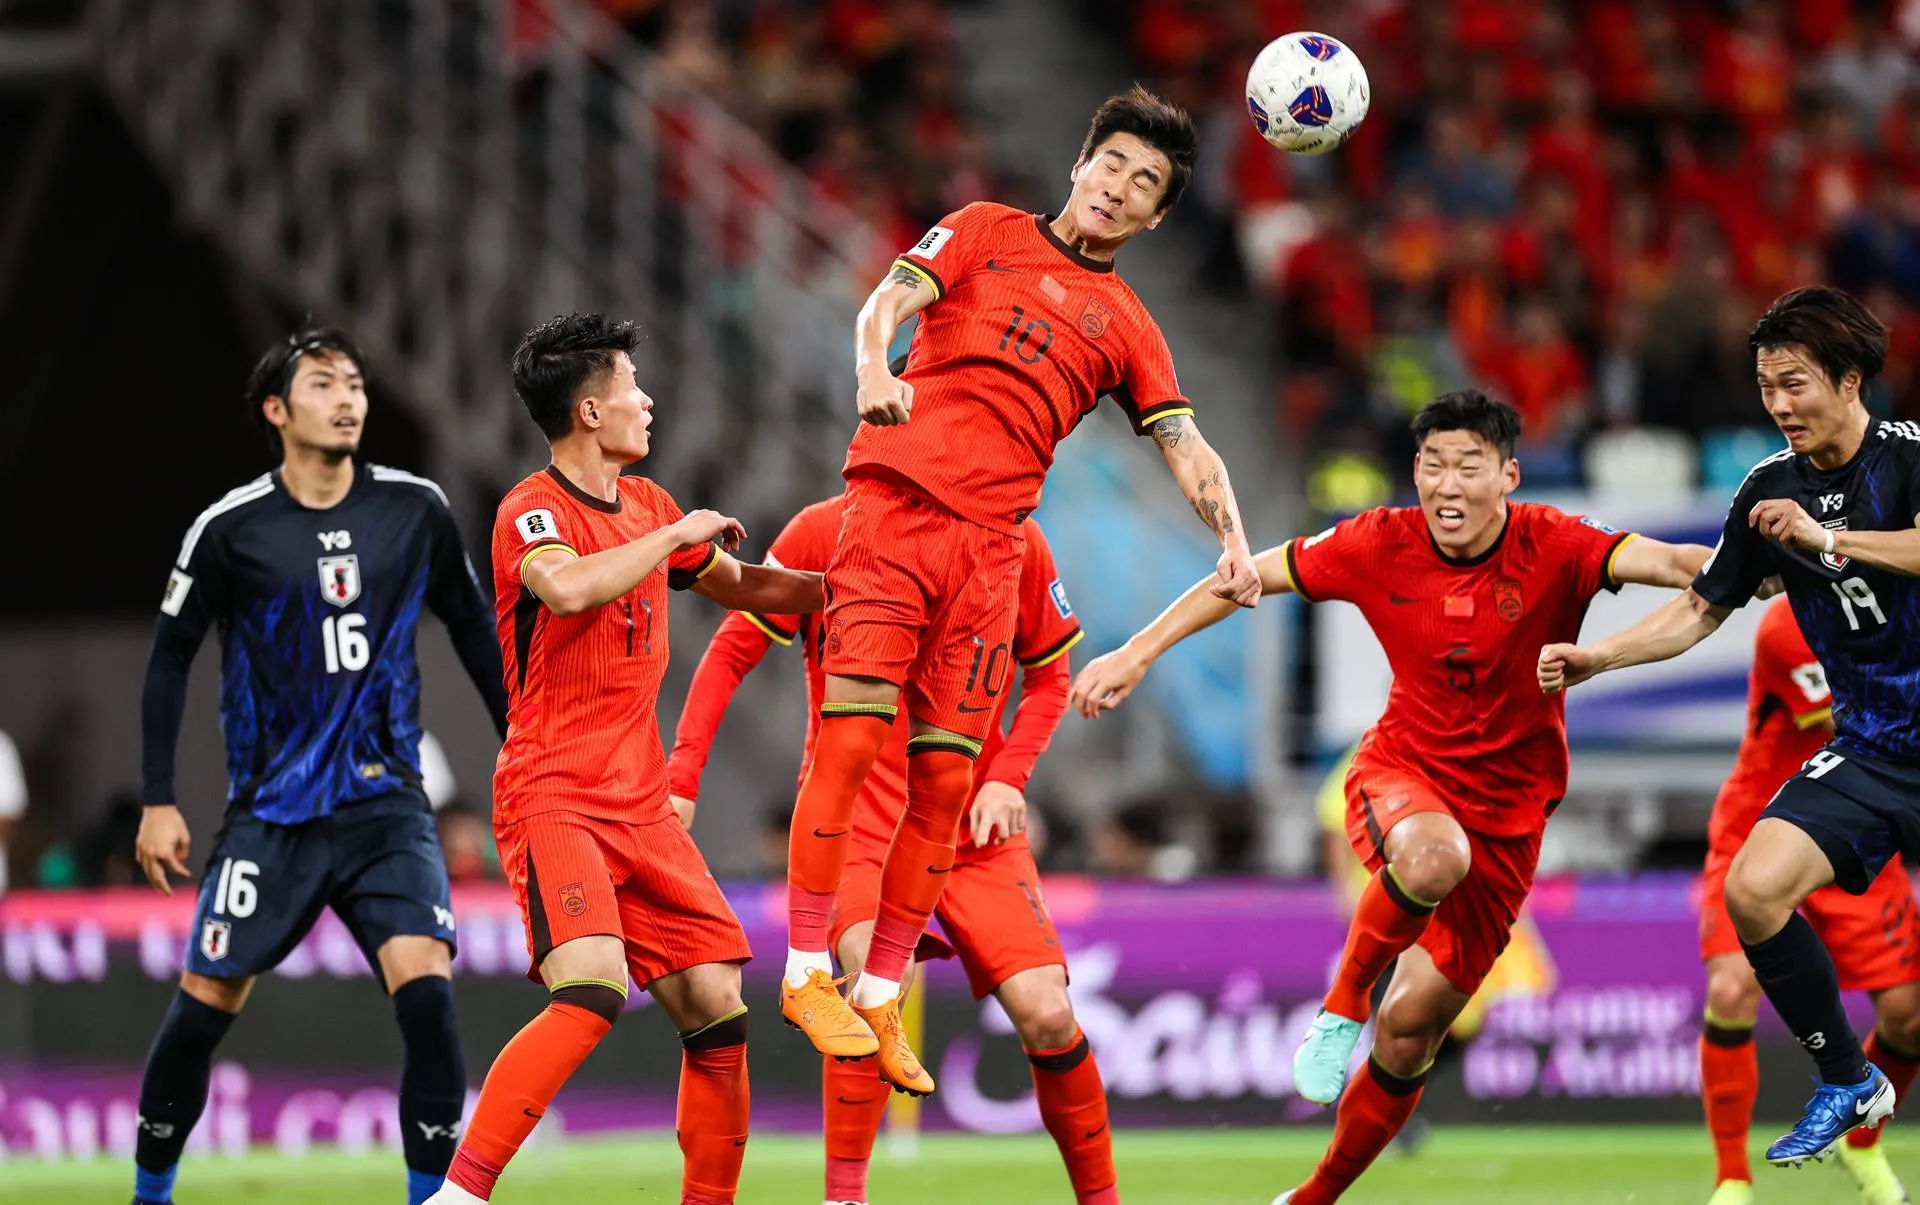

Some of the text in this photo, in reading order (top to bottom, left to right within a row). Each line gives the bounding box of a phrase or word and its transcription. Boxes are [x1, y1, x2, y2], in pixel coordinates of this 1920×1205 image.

[999, 305, 1053, 364] 10
[1818, 493, 1844, 513] Y-3
[624, 599, 652, 657] 11
[1831, 576, 1887, 631] 19
[322, 612, 370, 674] 16
[966, 636, 1009, 698] 10
[1445, 647, 1475, 692] 5
[214, 857, 260, 918] 16
[1796, 1031, 1826, 1050] -3
